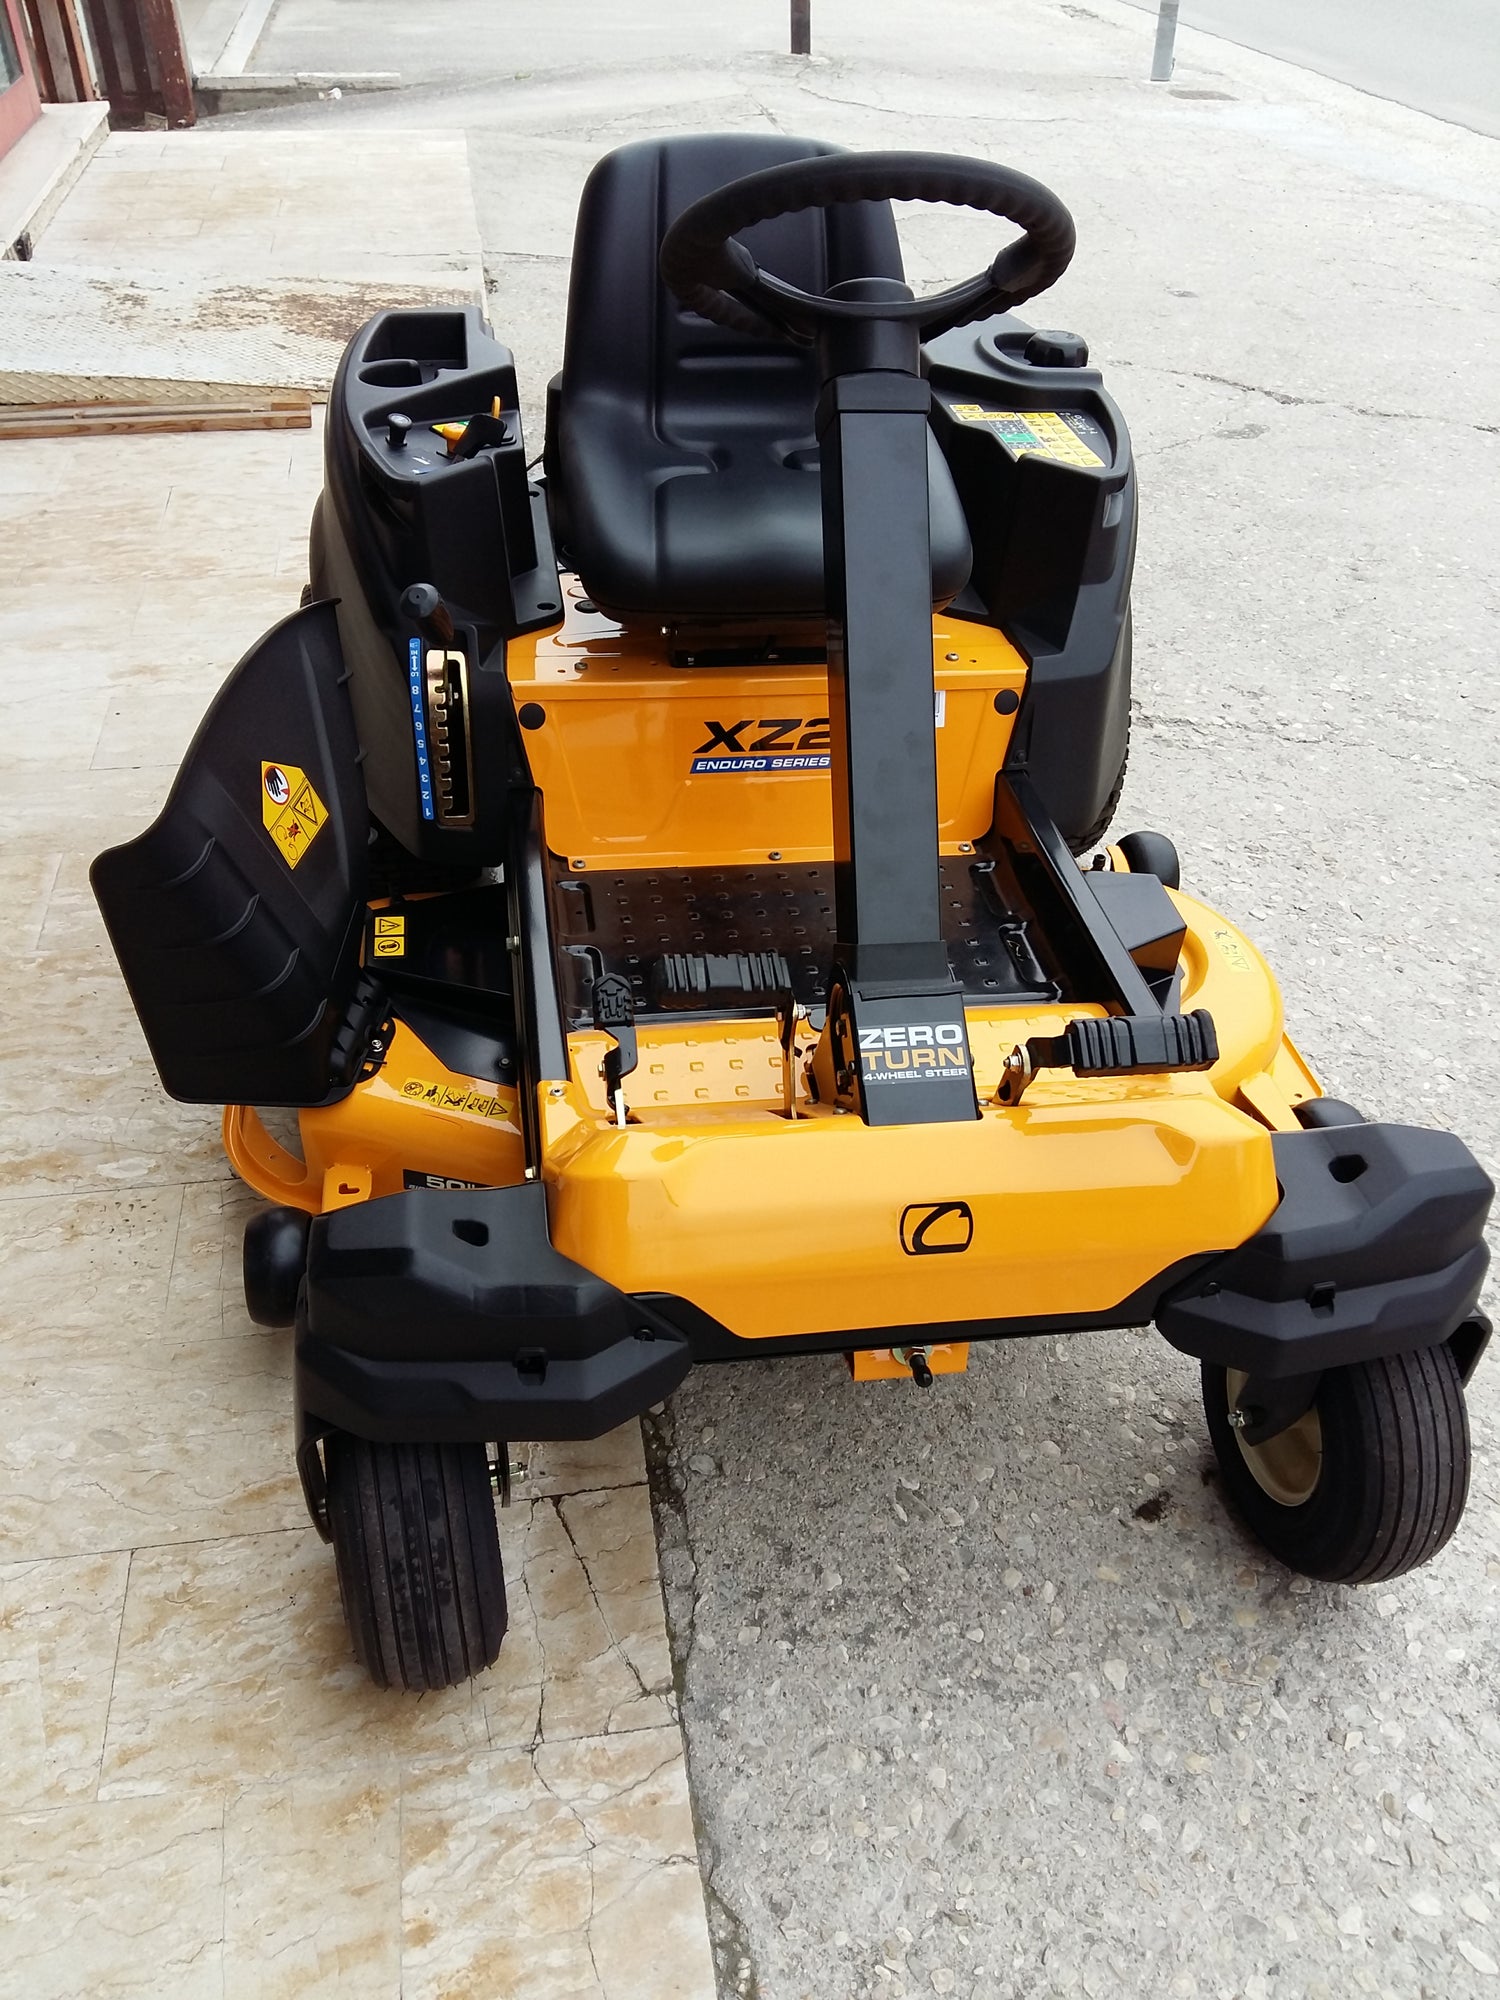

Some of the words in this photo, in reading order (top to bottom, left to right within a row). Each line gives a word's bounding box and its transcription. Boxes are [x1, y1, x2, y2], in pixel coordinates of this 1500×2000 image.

[411, 685, 419, 695] 8
[414, 705, 421, 713] 7
[415, 721, 423, 731] 6
[417, 740, 425, 749] 5
[418, 757, 427, 765] 4
[696, 759, 766, 771] ENDURO
[771, 756, 830, 768] SERIES
[421, 774, 429, 783] 3
[422, 791, 430, 800] 2
[425, 808, 431, 817] 1
[857, 1024, 963, 1049] ZERO
[860, 1047, 965, 1070] TURN
[863, 1070, 922, 1081] 4-WHEEL
[925, 1068, 968, 1078] STEER
